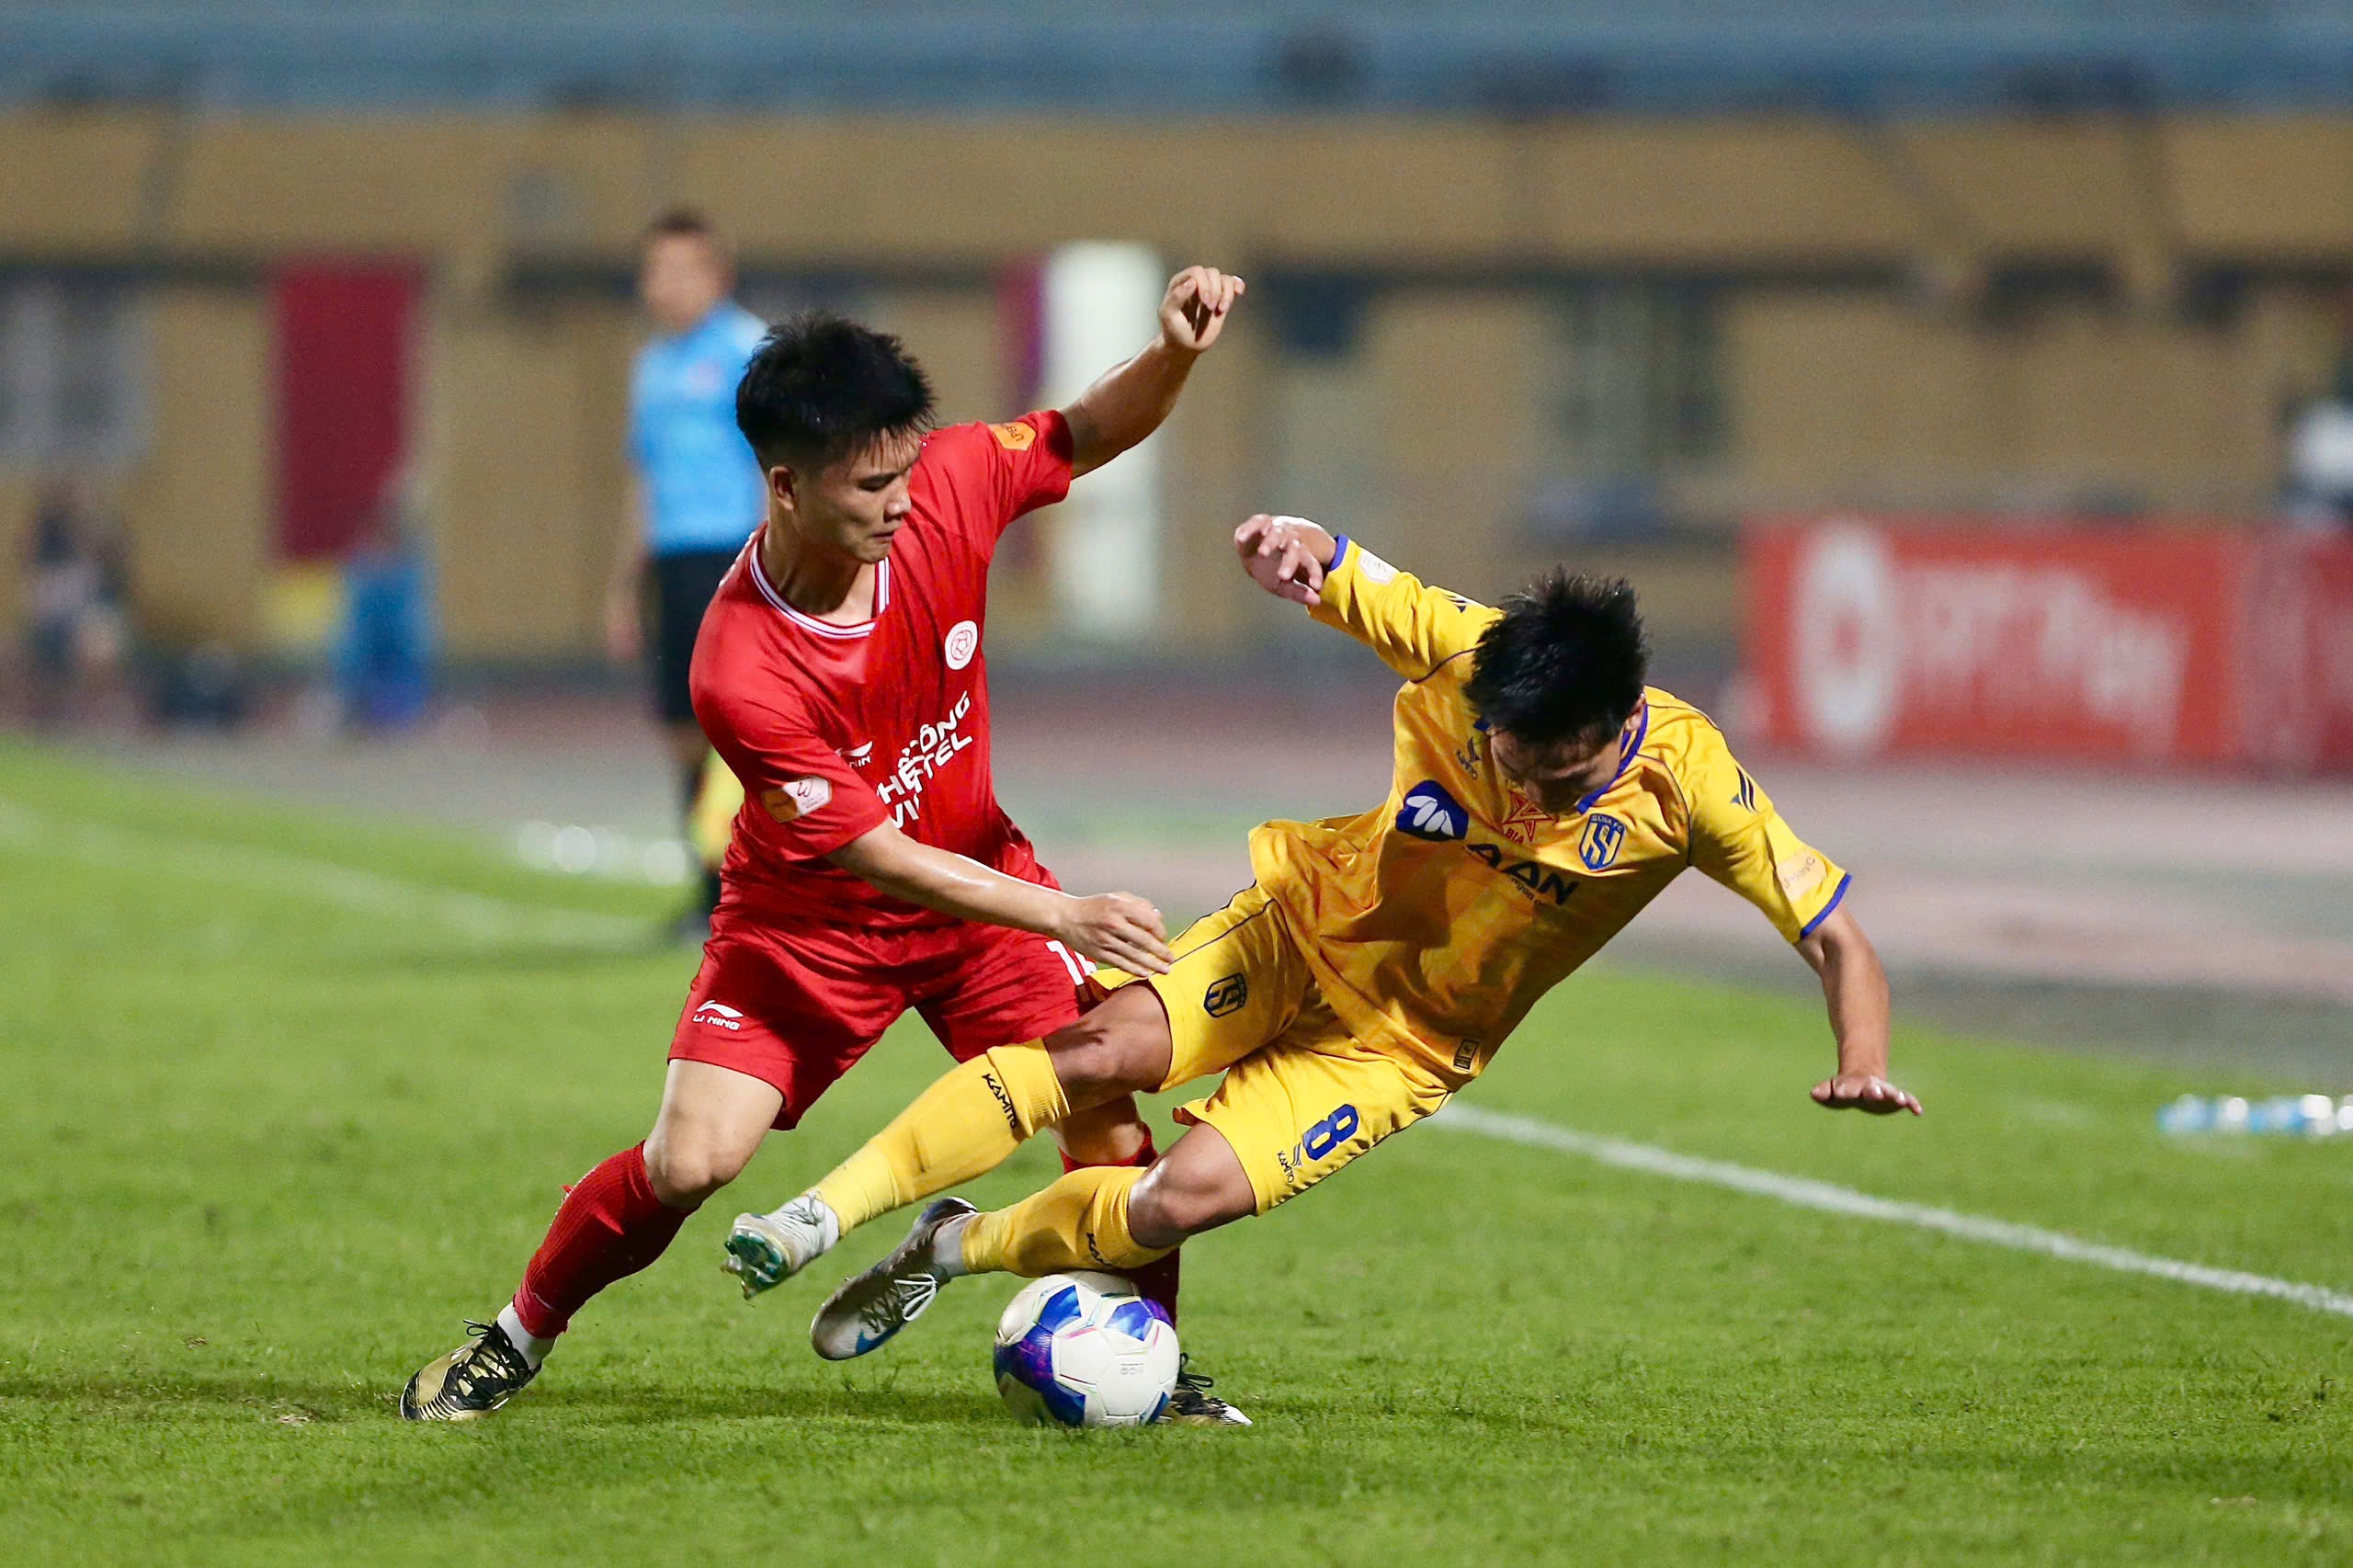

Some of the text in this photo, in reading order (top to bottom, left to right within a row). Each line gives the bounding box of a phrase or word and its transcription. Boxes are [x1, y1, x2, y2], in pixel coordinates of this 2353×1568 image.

[909, 690, 972, 754] ÔNG
[849, 754, 871, 768] NIN
[891, 732, 973, 829] VITTEL
[1506, 827, 1525, 845] BIA
[692, 1014, 741, 1030] LI NING
[1302, 1103, 1359, 1161] 8
